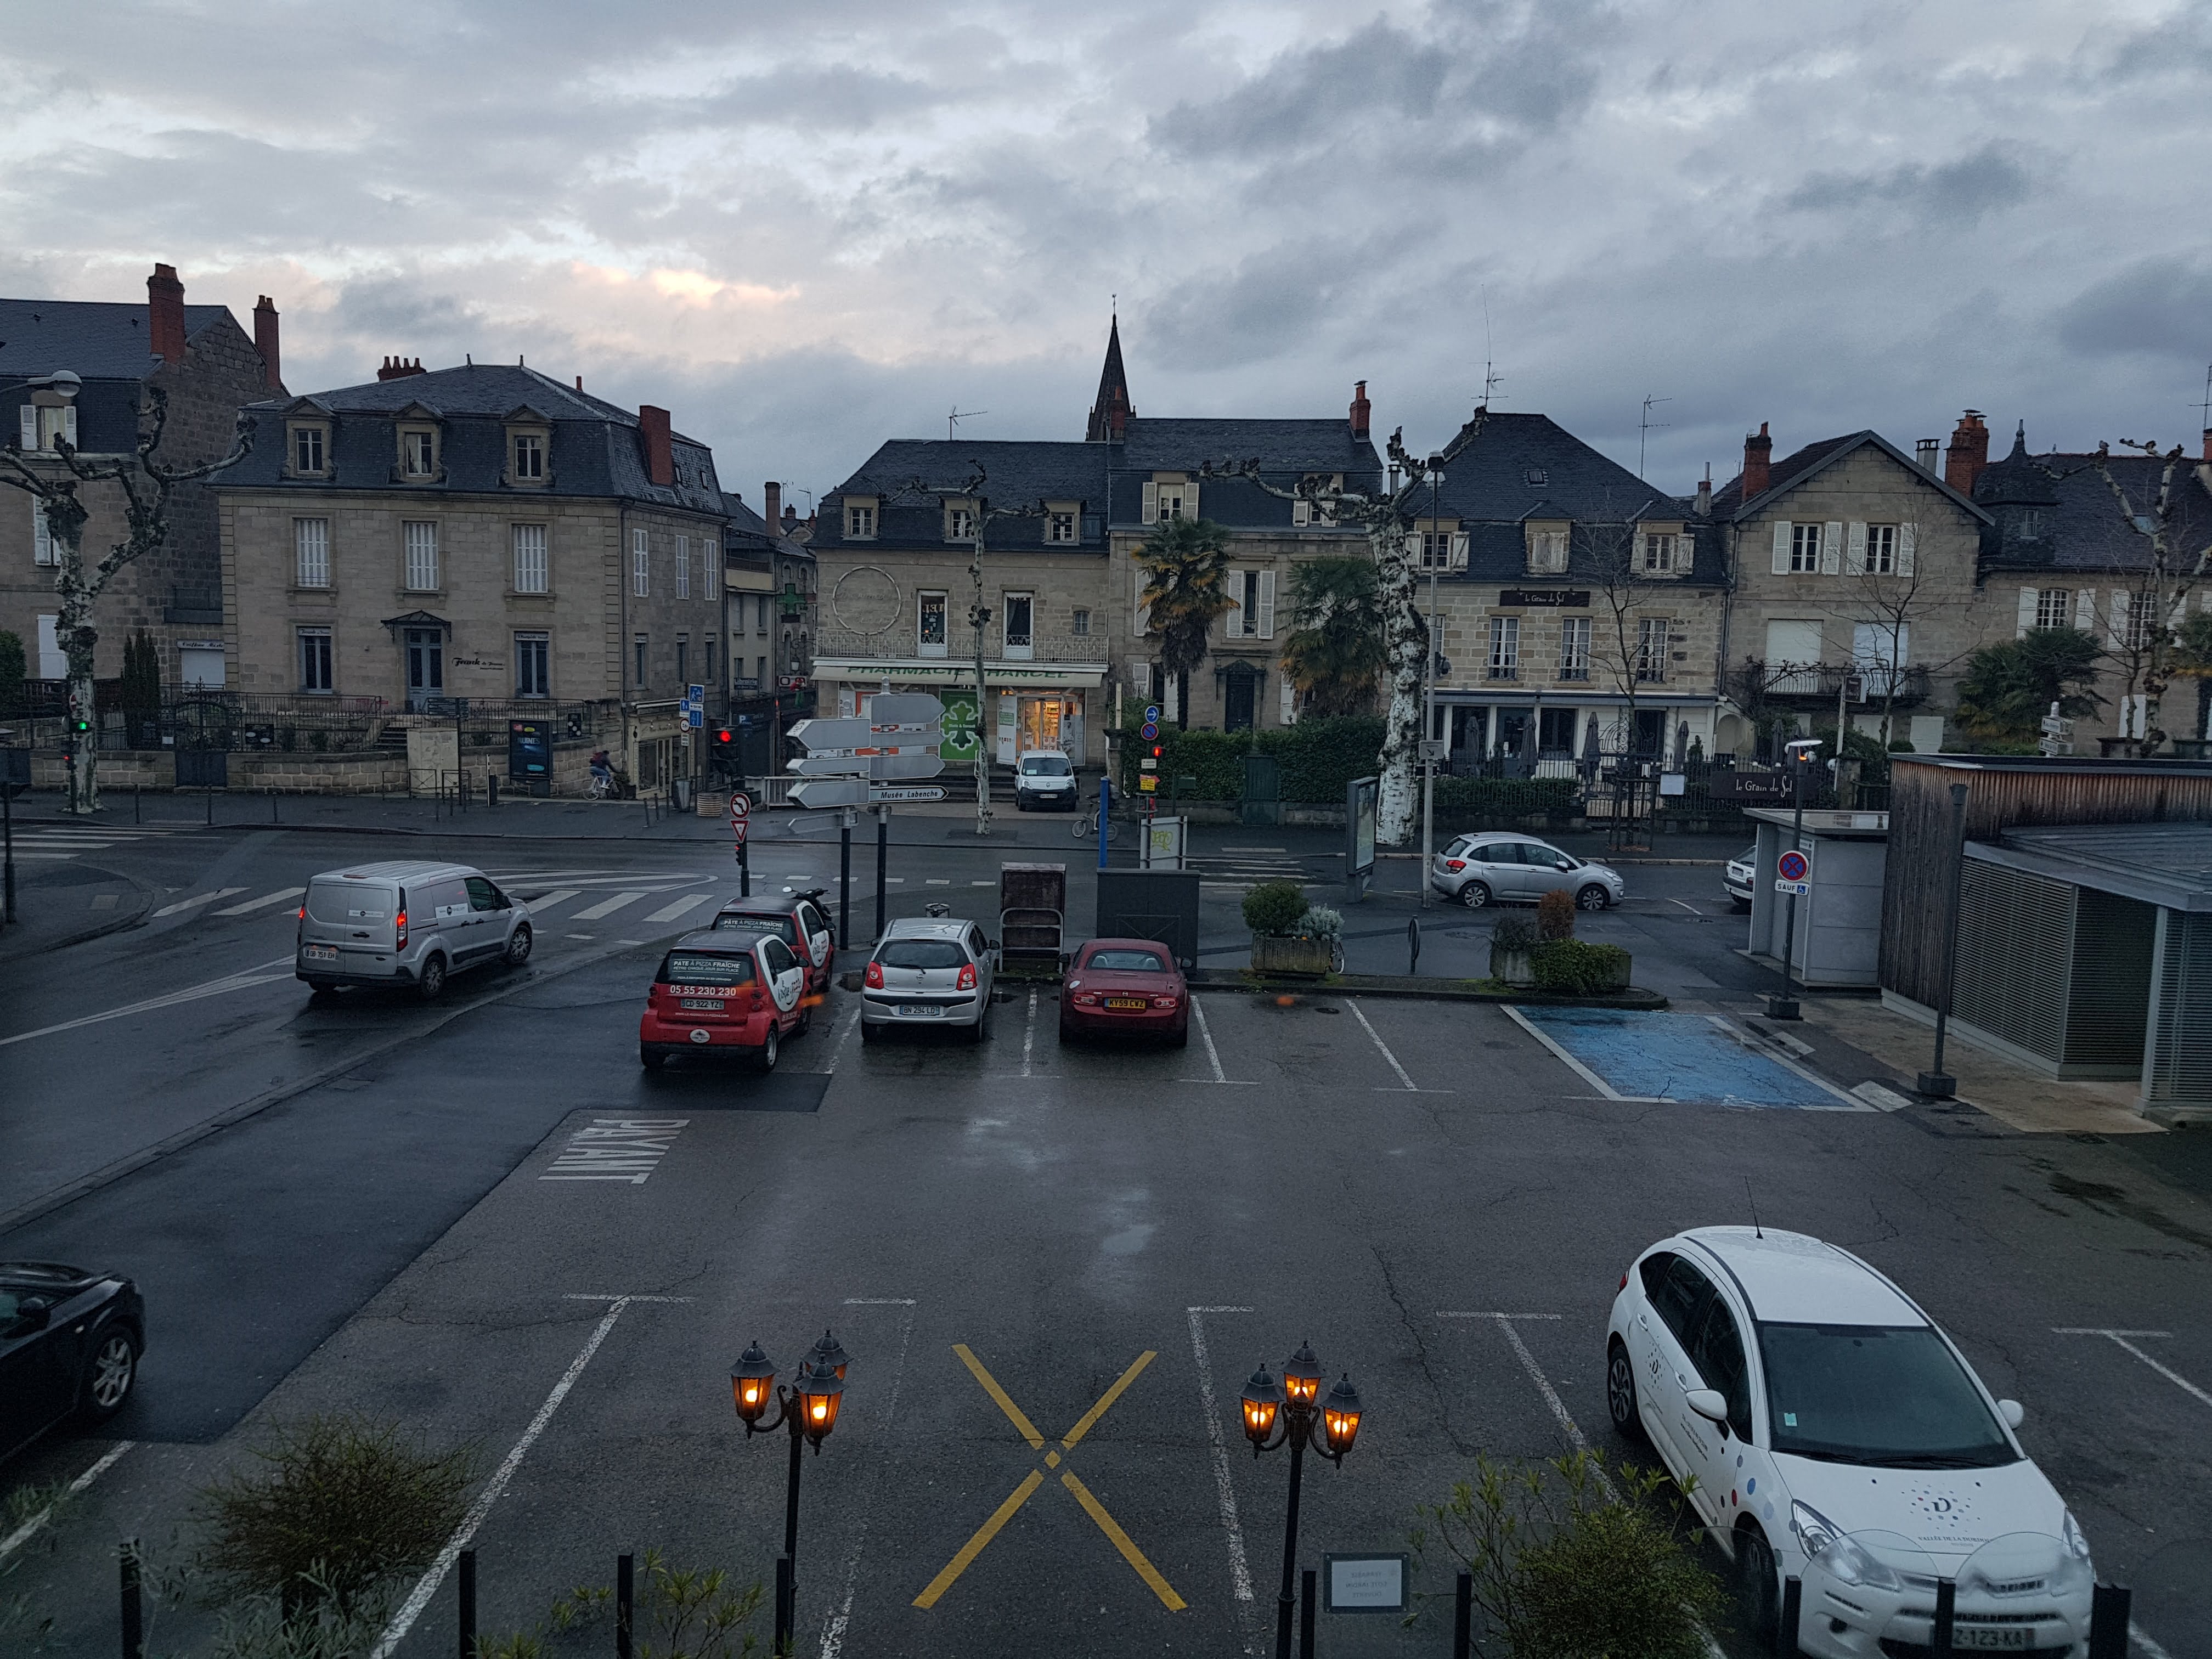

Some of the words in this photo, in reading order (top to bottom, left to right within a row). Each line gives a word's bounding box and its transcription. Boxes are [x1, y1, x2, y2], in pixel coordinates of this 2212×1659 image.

[848, 667, 966, 675] PHARMACIE
[1745, 781, 1767, 791] Grain
[1770, 777, 1779, 792] de
[1780, 775, 1792, 798] Sel
[670, 985, 681, 994] 05
[684, 986, 695, 994] 55
[697, 986, 715, 995] 230
[718, 988, 736, 996] 230
